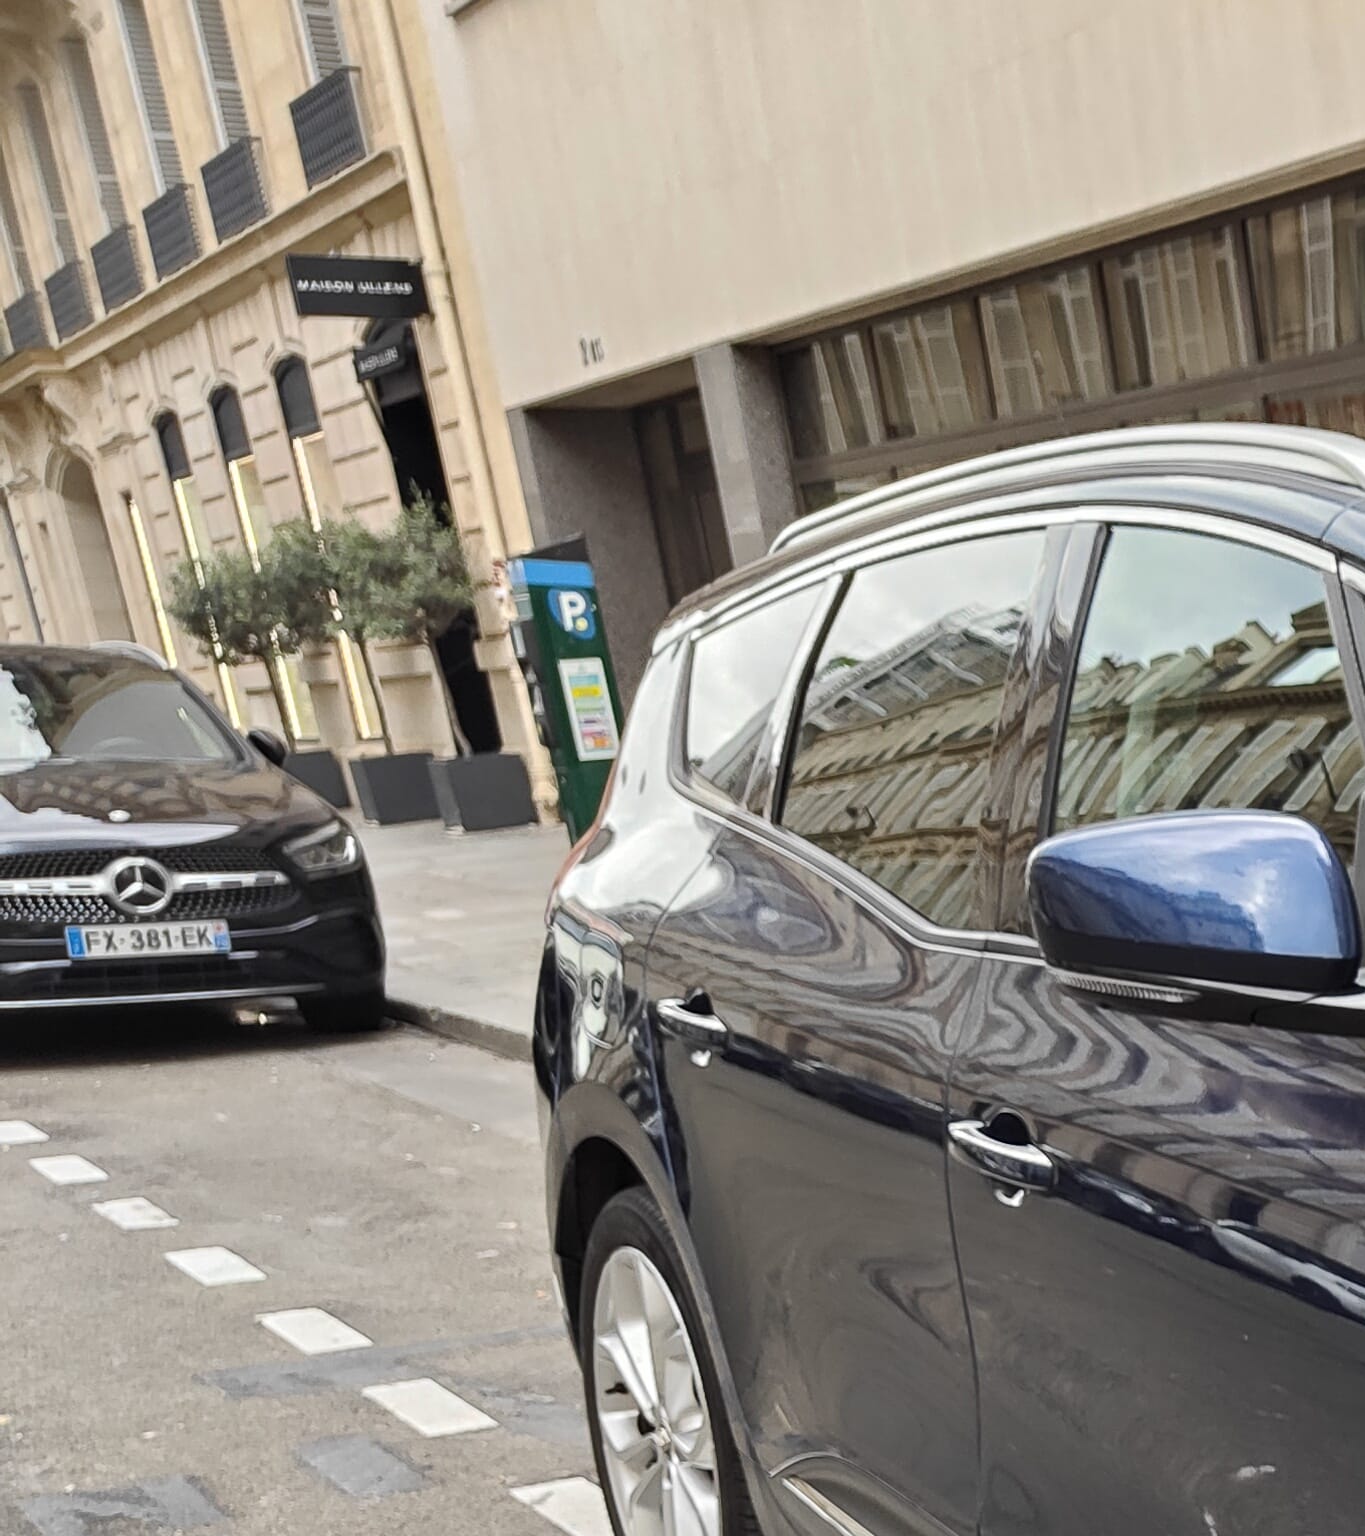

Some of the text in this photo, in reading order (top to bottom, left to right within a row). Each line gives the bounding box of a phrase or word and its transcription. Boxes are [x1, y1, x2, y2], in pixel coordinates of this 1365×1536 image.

[297, 279, 355, 293] MAISON
[558, 591, 587, 632] P
[85, 926, 213, 952] FX-381-EK
